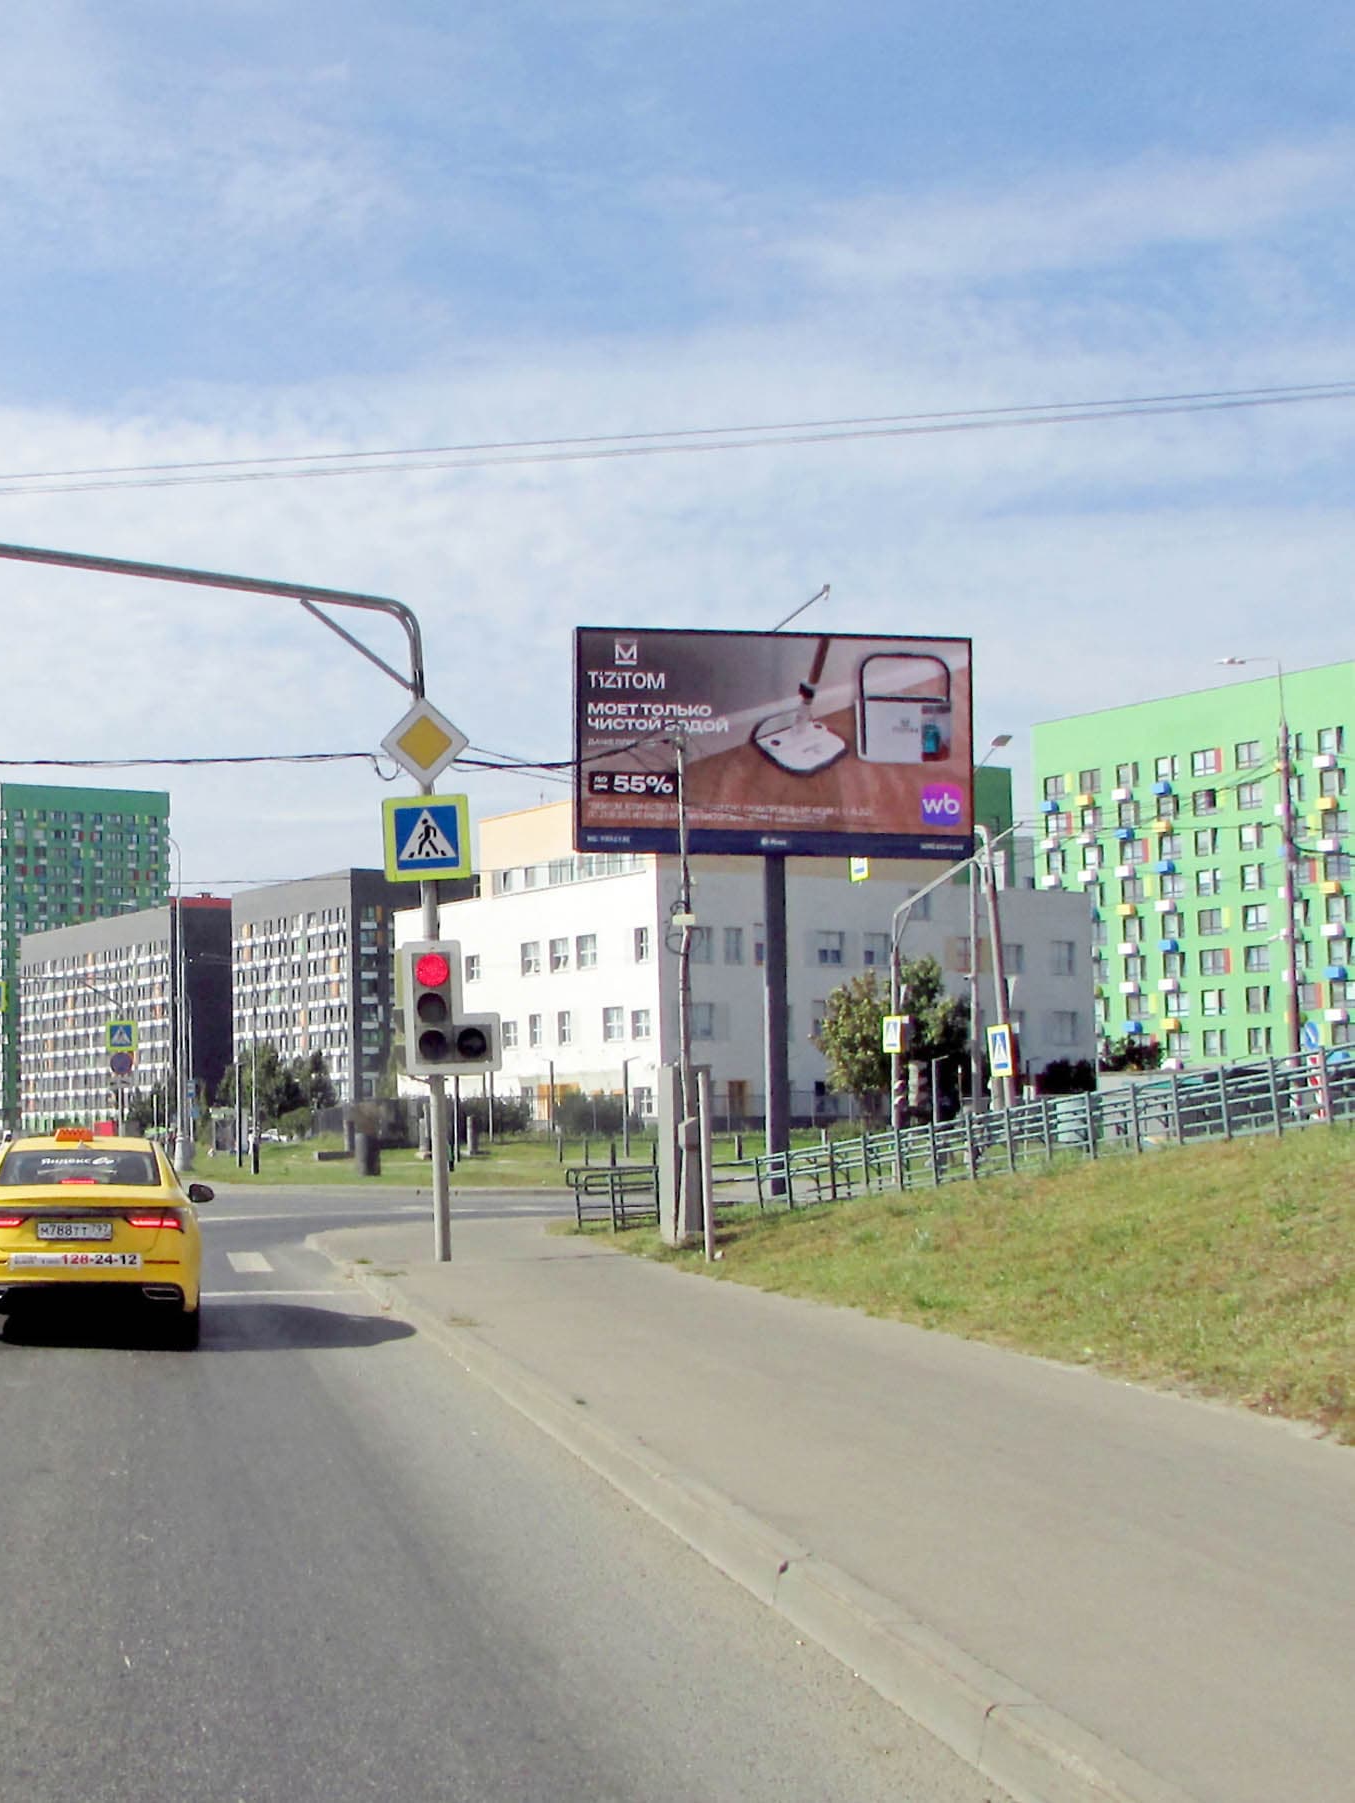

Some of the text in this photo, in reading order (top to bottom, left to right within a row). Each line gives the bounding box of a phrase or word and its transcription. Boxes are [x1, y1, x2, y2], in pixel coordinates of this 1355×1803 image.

[587, 671, 666, 690] TiZiTOM
[588, 702, 712, 718] МОЕТ ТОЛЬКО
[588, 716, 661, 731] ЧИСТОЙ
[922, 792, 960, 815] wb
